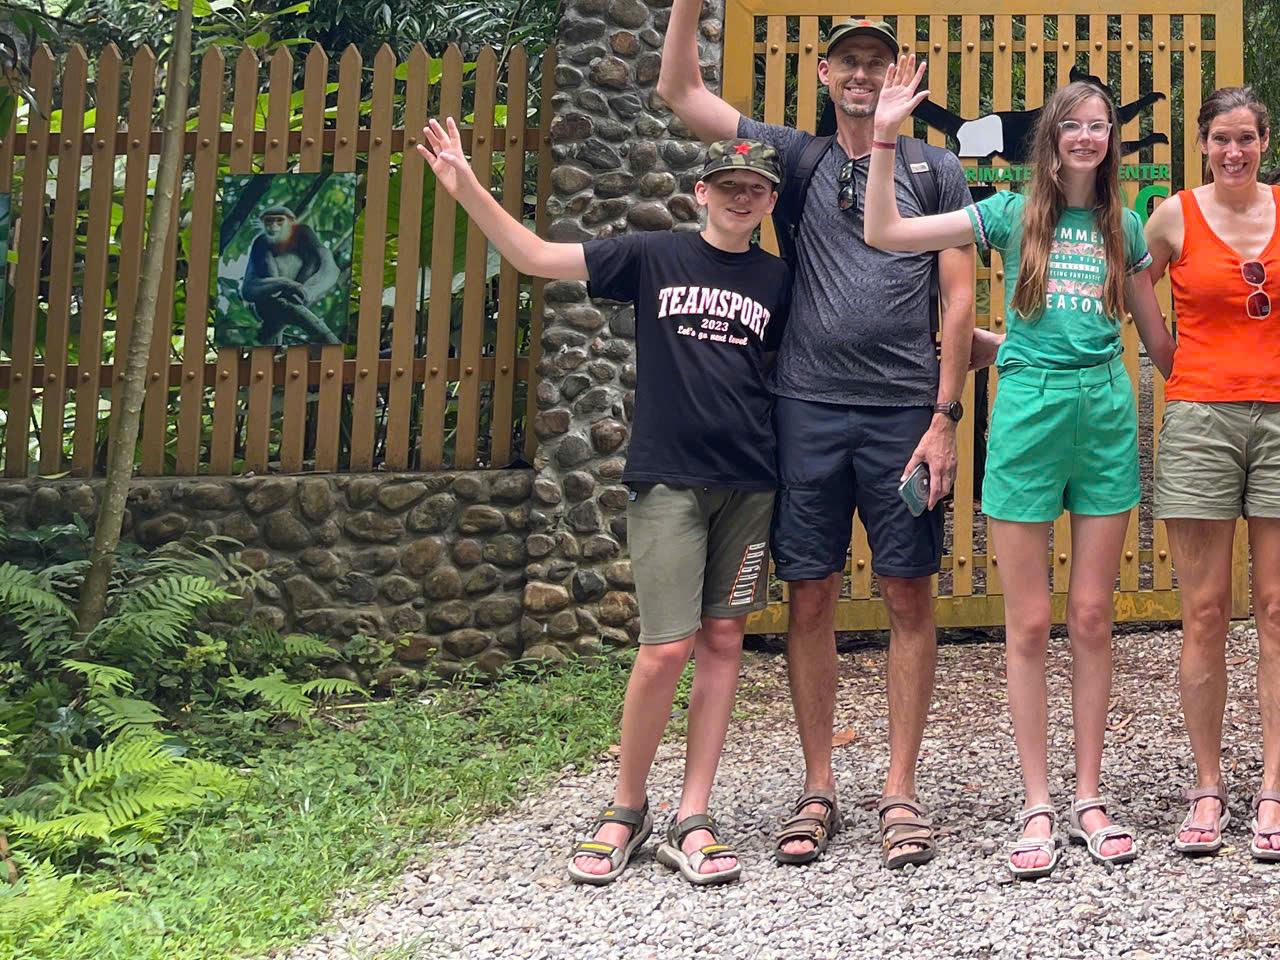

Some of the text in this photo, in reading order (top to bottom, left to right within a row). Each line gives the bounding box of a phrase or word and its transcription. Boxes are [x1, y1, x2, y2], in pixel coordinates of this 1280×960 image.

[965, 163, 1170, 182] RIMATE ENTER
[1053, 226, 1104, 244] MME
[657, 286, 772, 342] TEAMSPORT
[1046, 293, 1103, 316] EASON
[700, 318, 730, 332] 2023
[730, 541, 766, 606] BRIGHTON
